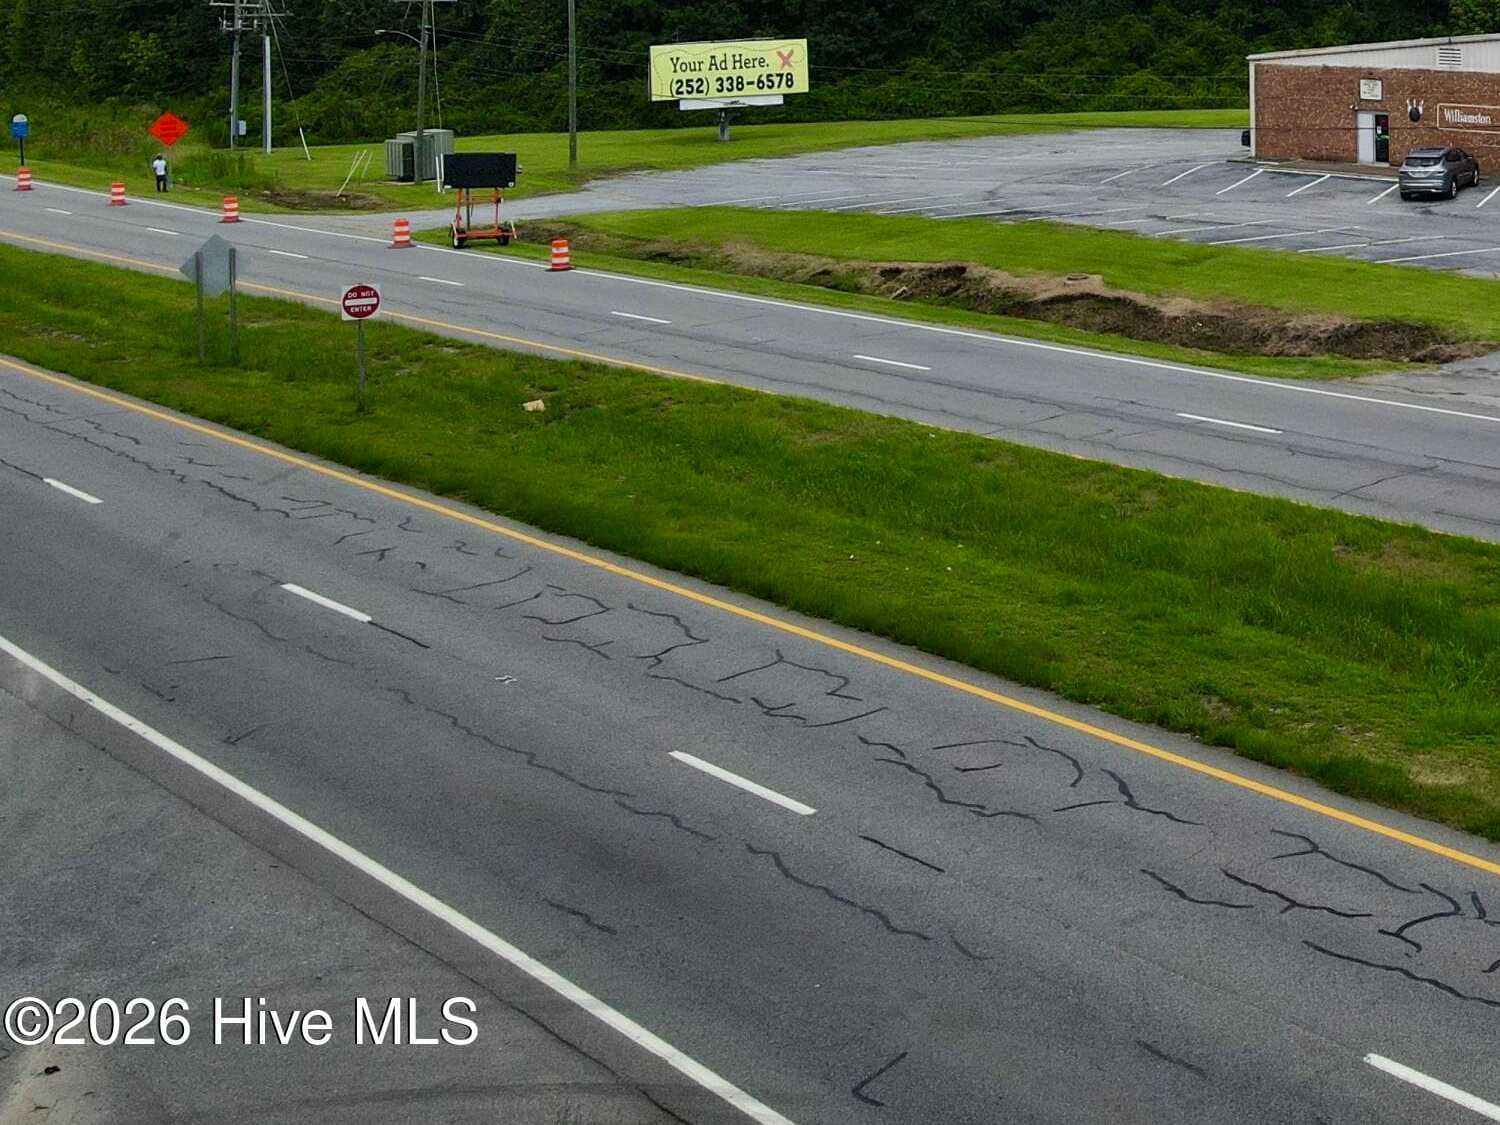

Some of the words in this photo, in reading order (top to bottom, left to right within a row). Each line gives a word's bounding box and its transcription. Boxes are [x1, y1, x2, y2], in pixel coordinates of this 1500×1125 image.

[670, 56, 704, 73] Your
[708, 53, 728, 71] Ad
[732, 53, 769, 69] Here.
[670, 75, 709, 97] (252)
[716, 72, 794, 93] 338-6578
[1444, 108, 1491, 124] Williamston
[360, 290, 375, 298] NOT
[350, 305, 372, 313] ENTER
